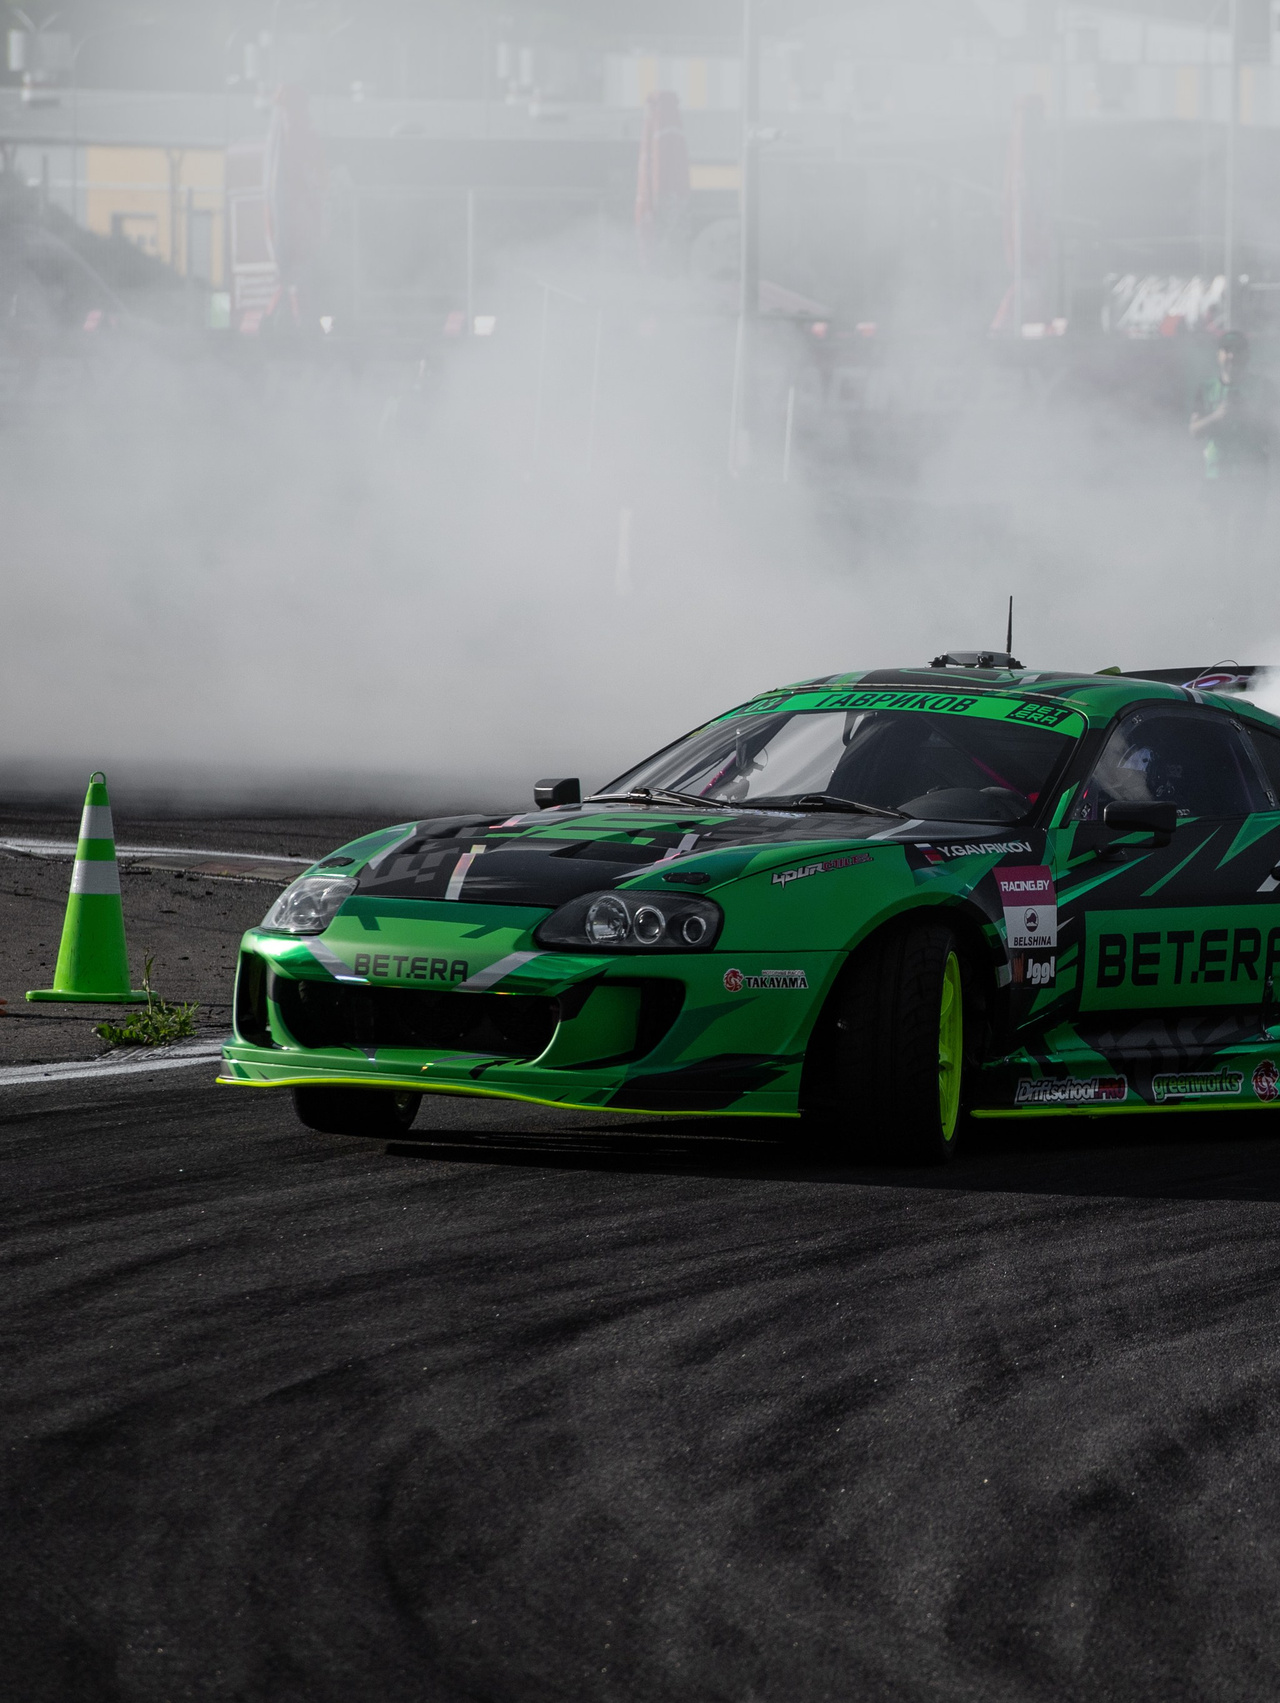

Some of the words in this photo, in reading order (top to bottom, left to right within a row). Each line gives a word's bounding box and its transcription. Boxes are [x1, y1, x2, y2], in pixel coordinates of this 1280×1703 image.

[814, 692, 979, 713] ГАВРИКОВ
[1022, 703, 1069, 717] BET
[937, 841, 1033, 857] Y.GAVRIKOV
[1000, 880, 1050, 892] RACING.BY
[1013, 935, 1052, 947] BELSHINA
[745, 976, 808, 988] TAKAYAMA
[1153, 1067, 1241, 1100] greenworks
